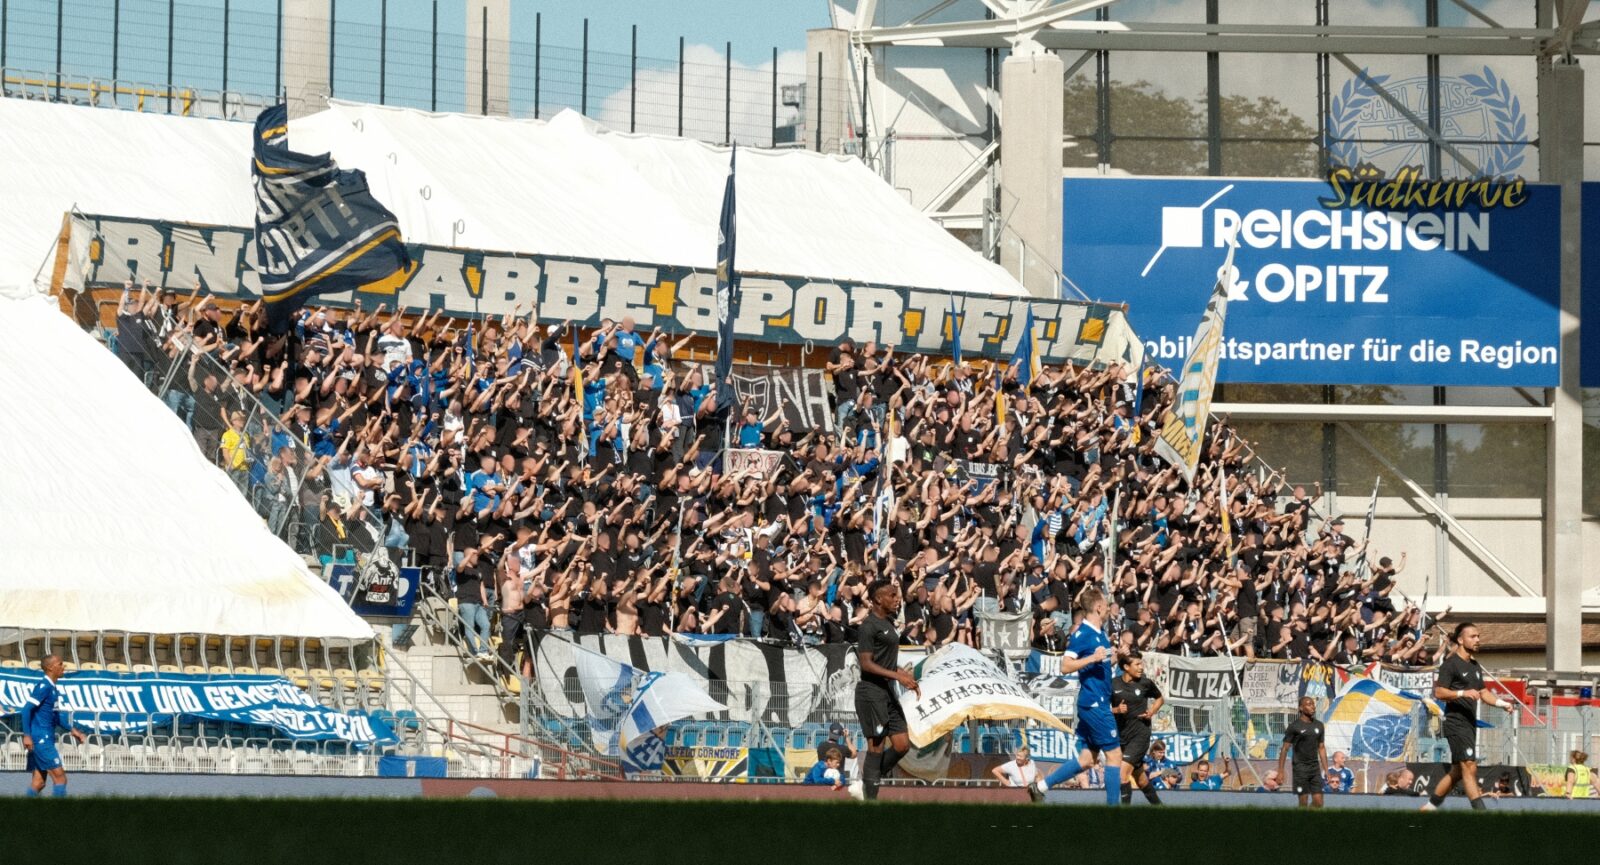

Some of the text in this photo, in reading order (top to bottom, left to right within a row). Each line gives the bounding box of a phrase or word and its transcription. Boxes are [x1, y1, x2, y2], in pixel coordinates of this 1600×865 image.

[1217, 263, 1389, 303] & OPITZ
[400, 250, 658, 325] ABBE
[676, 271, 1116, 361] SPORTFEL
[1143, 335, 1558, 369] obilätspartner für die Region
[0, 679, 148, 713] KONEQUENT
[1169, 669, 1232, 698] ULTRA
